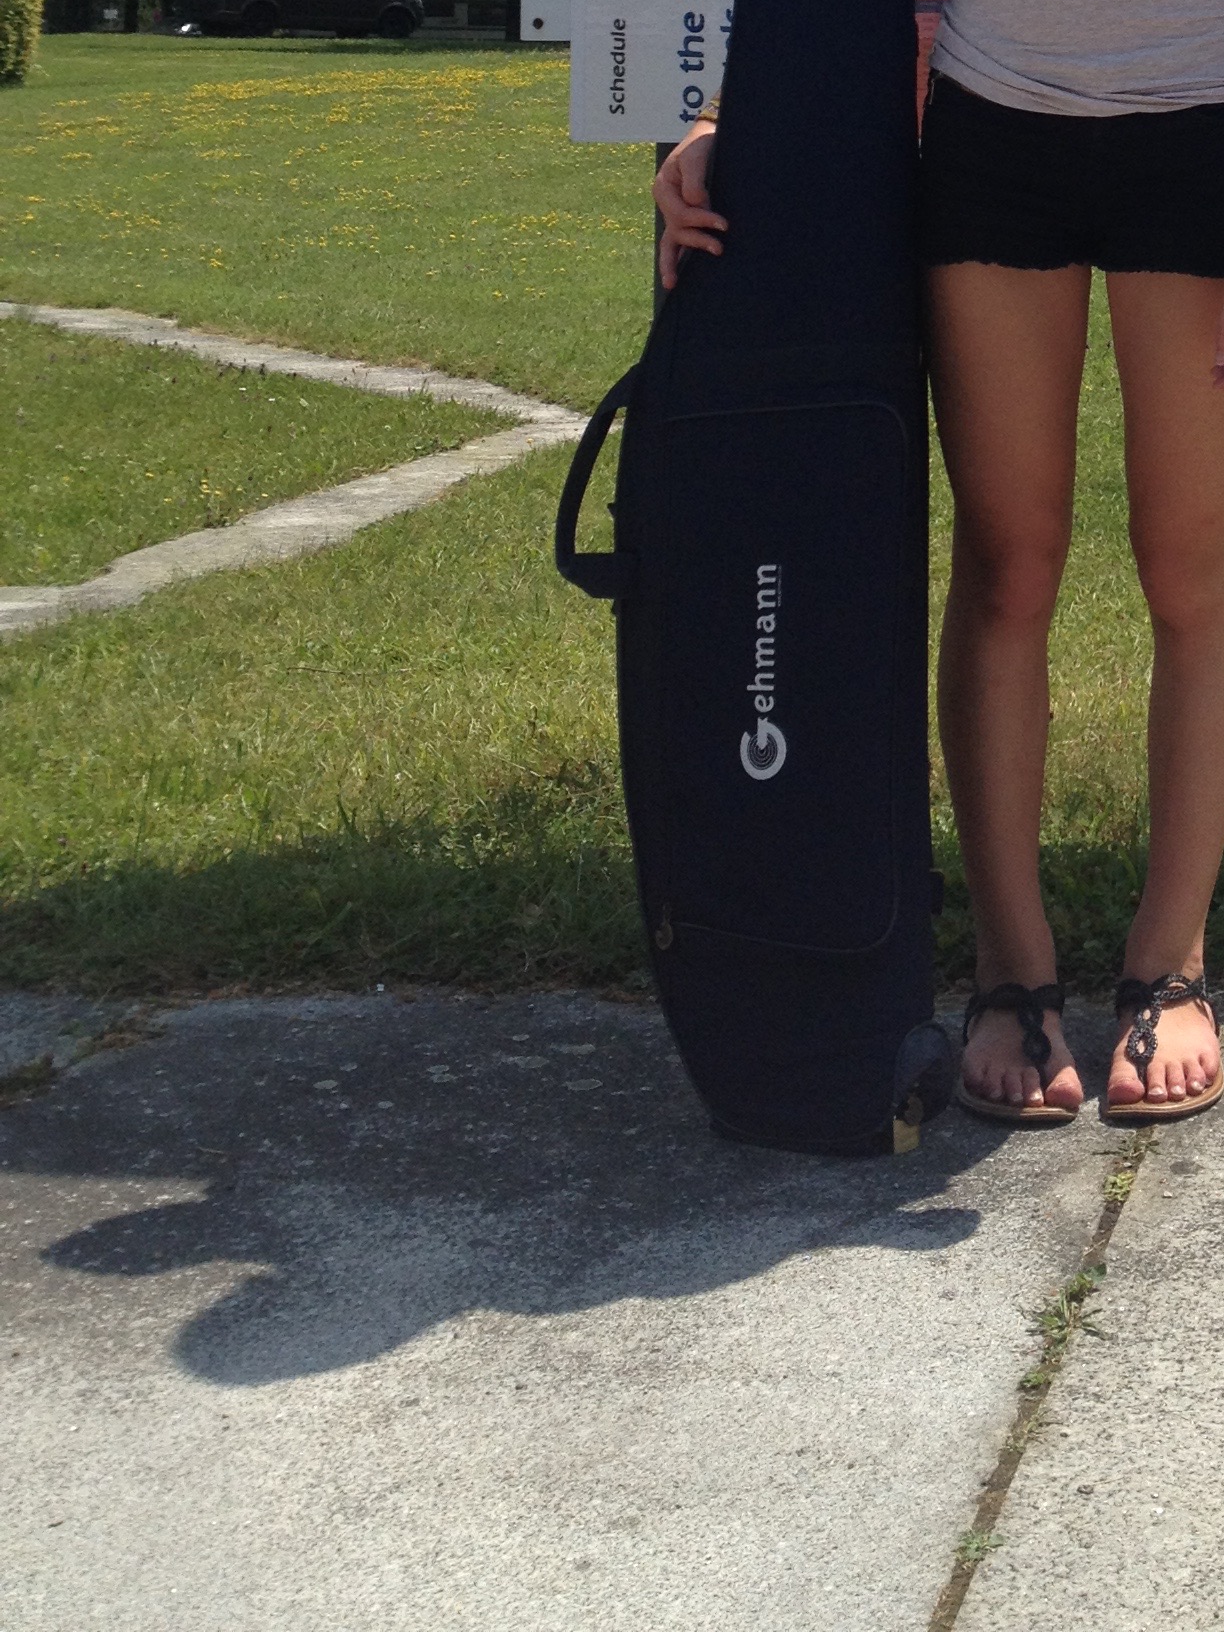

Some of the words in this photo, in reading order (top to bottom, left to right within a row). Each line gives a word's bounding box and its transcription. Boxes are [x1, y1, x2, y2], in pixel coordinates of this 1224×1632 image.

[609, 18, 627, 116] Schedule
[677, 11, 705, 73] the
[739, 564, 788, 781] Gehmann
